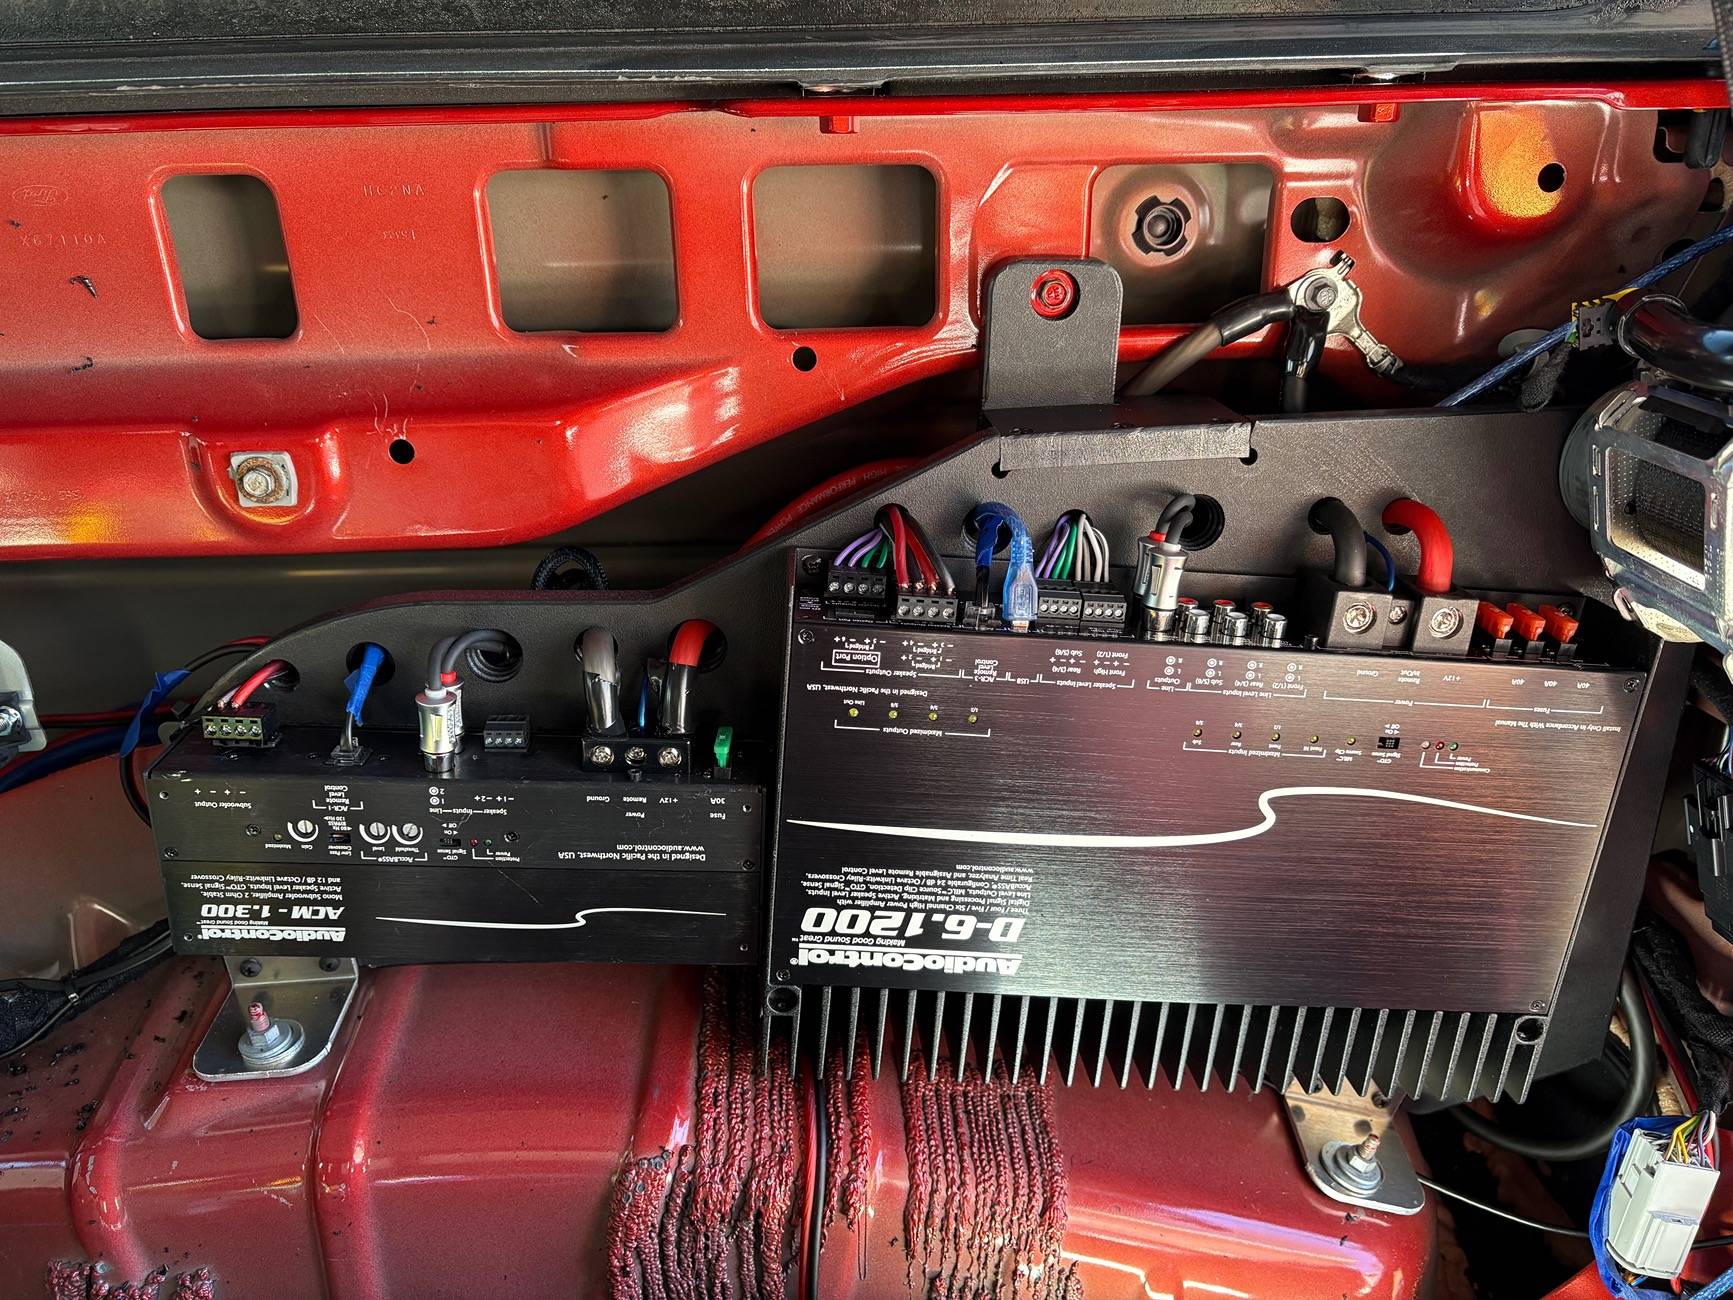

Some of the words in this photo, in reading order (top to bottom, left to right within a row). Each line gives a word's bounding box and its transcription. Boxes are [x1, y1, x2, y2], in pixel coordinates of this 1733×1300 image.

[853, 654, 878, 662] Option
[893, 670, 917, 678] Speaker
[900, 688, 928, 697] Designed
[1546, 722, 1579, 730] Accordance
[617, 844, 704, 852] www.audiocontrol.com
[577, 851, 620, 859] Northwest,
[622, 852, 645, 860] Pacific
[672, 852, 705, 861] Designed
[956, 864, 1034, 874] www.audiocontrol.com
[226, 874, 274, 882] Linkwitz-Riley
[916, 870, 952, 878] Assignable
[824, 882, 844, 890] Signal
[948, 880, 989, 888] Configurable
[854, 899, 885, 907] Amplifier
[951, 895, 985, 904] Processing
[987, 897, 1006, 905] Signal
[1008, 898, 1030, 906] Digital
[910, 902, 925, 910] High
[201, 904, 271, 918] 1.300
[291, 906, 344, 919] ACM
[800, 908, 1026, 942] D-6.1200
[824, 936, 851, 944] Sound
[852, 937, 874, 945] Good
[876, 937, 905, 946] Making
